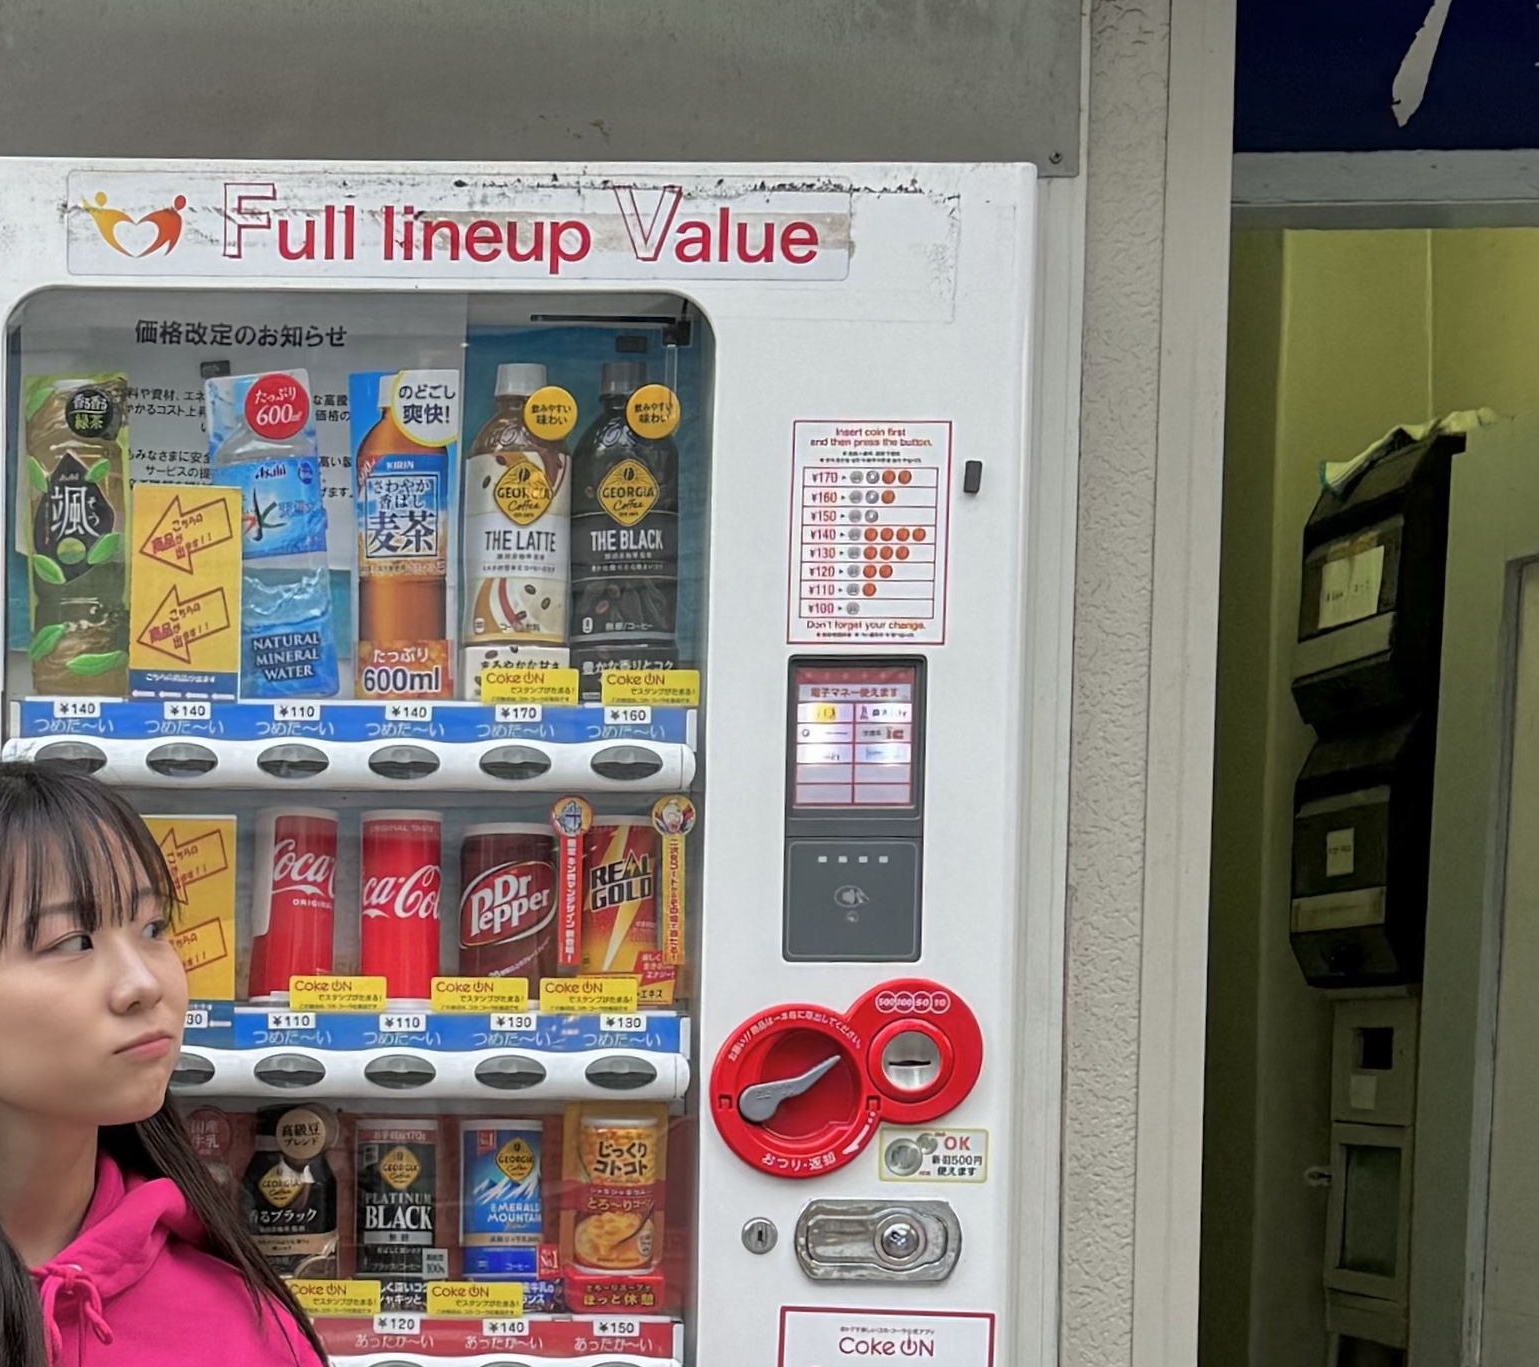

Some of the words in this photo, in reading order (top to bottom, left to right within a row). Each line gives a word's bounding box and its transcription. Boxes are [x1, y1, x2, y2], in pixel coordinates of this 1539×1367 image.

[223, 182, 355, 261] Full
[383, 210, 591, 275] lineup
[615, 184, 819, 264] Value
[134, 320, 347, 349] 価格改定のお知らせ
[255, 386, 297, 404] たっぷり
[399, 384, 456, 400] のどごし
[402, 404, 450, 424] 爽快!
[75, 414, 103, 430] 緑茶
[865, 428, 885, 437] coin
[888, 428, 906, 437] first
[831, 439, 851, 447] then
[883, 439, 899, 447] the
[387, 461, 414, 469] KIRIN
[374, 479, 429, 496] さわやか
[602, 487, 654, 498] GEORGIA
[367, 510, 435, 554] 麦茶
[485, 530, 512, 550] THE
[516, 530, 556, 552] LATTE
[590, 530, 616, 551] THE
[620, 529, 663, 550] BLACK
[253, 632, 320, 650] NATURAL
[256, 649, 319, 666] MINERAL
[373, 647, 429, 663] たっぷり
[265, 664, 314, 681] WATER
[364, 666, 440, 692] 600ml
[486, 674, 521, 684] Coke
[607, 675, 642, 685] Coke
[60, 702, 95, 715] ¥140
[169, 704, 206, 717] ¥140
[279, 706, 314, 718] ¥110
[392, 706, 427, 718] ¥140
[500, 707, 537, 720] ¥170
[610, 709, 646, 722] ¥160
[591, 849, 651, 889] REAL
[494, 870, 532, 896] Dr
[592, 875, 652, 912] GOLD
[470, 884, 550, 936] Pepper
[294, 980, 329, 992] Coke
[436, 982, 470, 993] Coke
[545, 982, 579, 994] Coke
[273, 1016, 309, 1026] ¥110
[385, 1017, 420, 1028] ¥110
[496, 1017, 532, 1028] ¥130
[606, 1018, 642, 1028] ¥130
[282, 1123, 321, 1137] 高級豆
[284, 1137, 319, 1146] ブレンド
[944, 1136, 970, 1150] OK
[599, 1142, 647, 1158] じっくり
[594, 1160, 647, 1176] コトコト
[938, 1167, 976, 1176] 使えます
[366, 1193, 431, 1204] PLATINUM
[490, 1203, 540, 1212] EMERALD
[365, 1206, 432, 1229] BLACK
[488, 1213, 541, 1223] MOUNTAIN
[432, 1286, 466, 1298] Coke
[378, 1317, 415, 1330] ¥120
[488, 1322, 524, 1334] ¥140
[599, 1322, 635, 1334] ¥150
[839, 1337, 895, 1356] Coke
